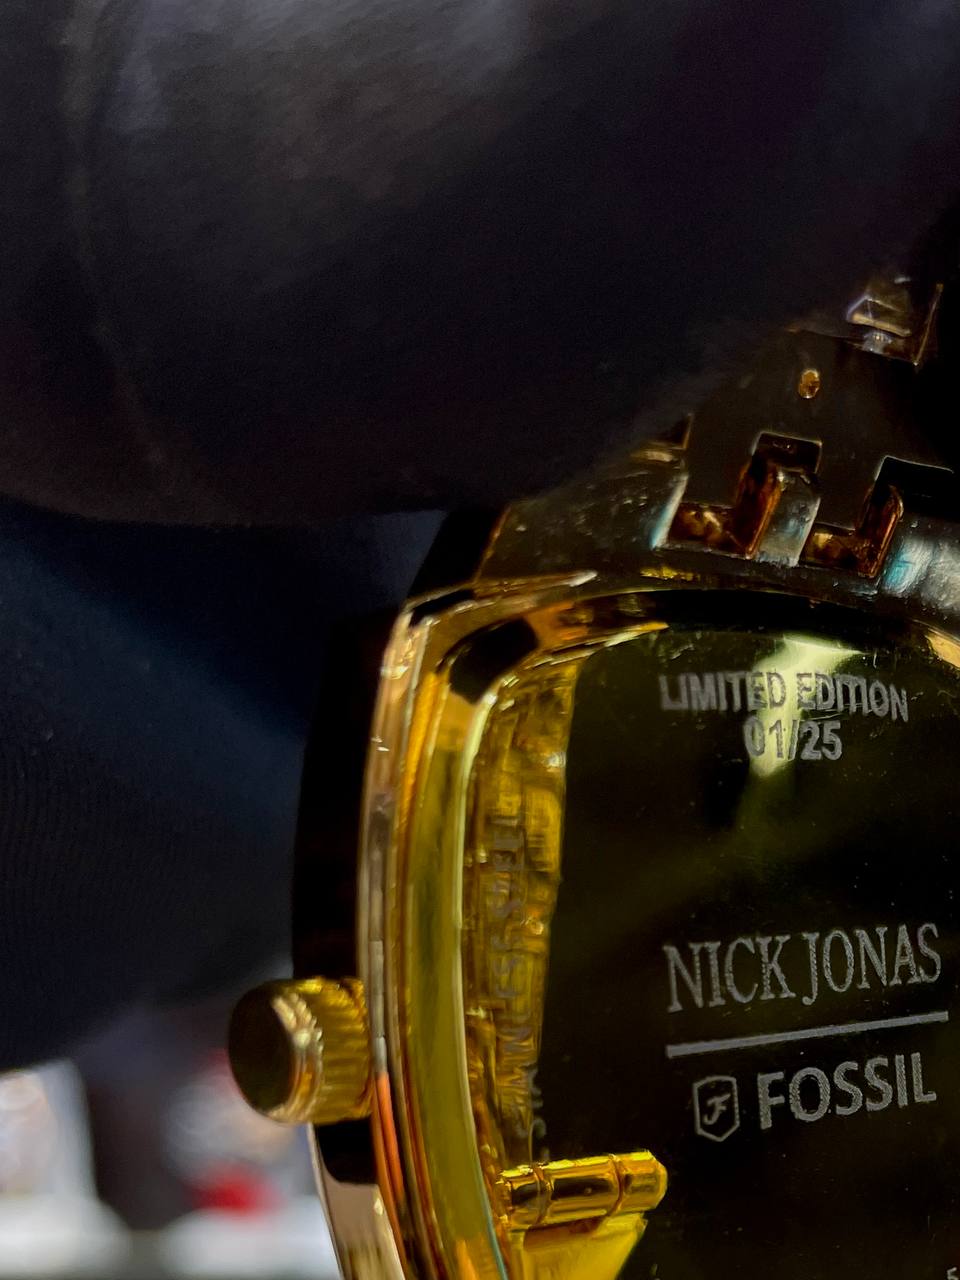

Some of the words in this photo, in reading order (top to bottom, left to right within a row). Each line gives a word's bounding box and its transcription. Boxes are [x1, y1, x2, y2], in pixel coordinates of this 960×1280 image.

[659, 670, 787, 712] LIMITED
[796, 672, 908, 722] EDITION
[743, 716, 843, 760] 01/25
[662, 933, 796, 1013] NICK
[802, 923, 942, 1006] JONAS
[756, 1052, 938, 1131] FOSSIL
